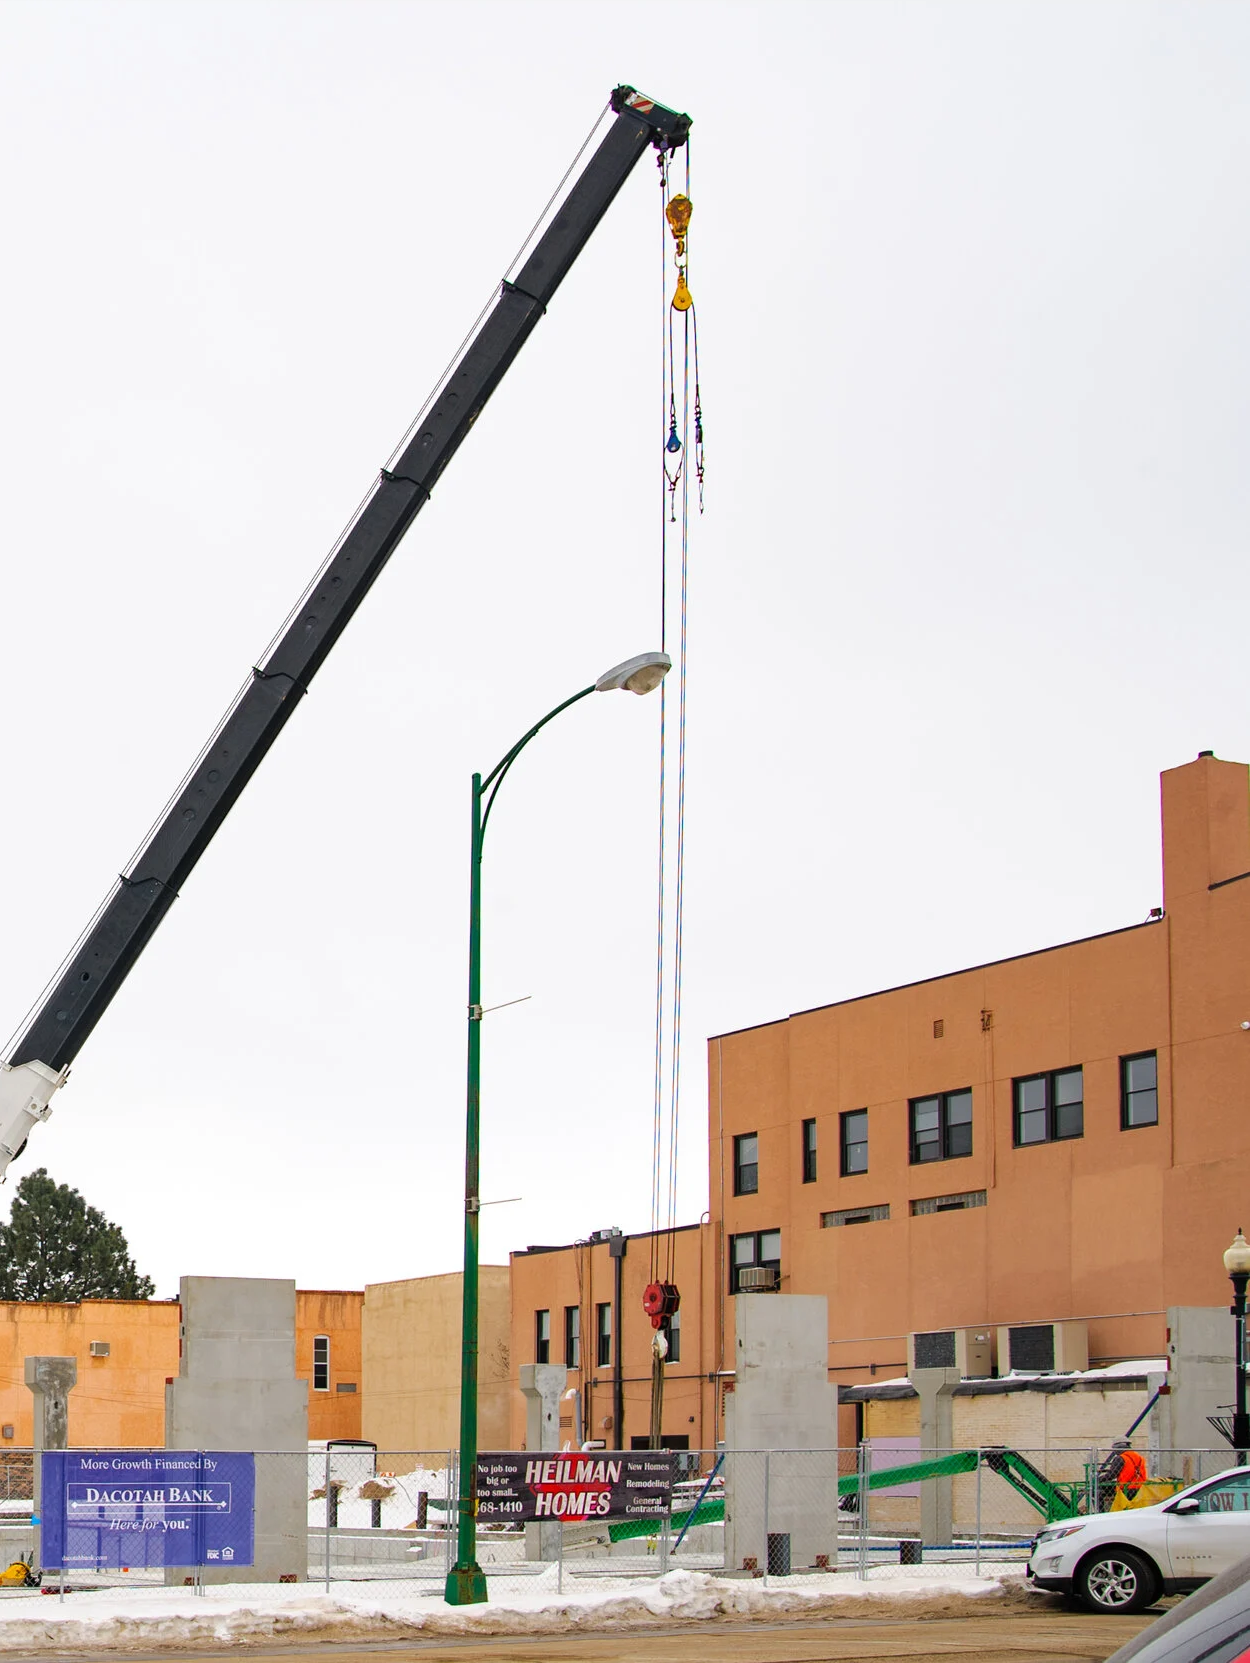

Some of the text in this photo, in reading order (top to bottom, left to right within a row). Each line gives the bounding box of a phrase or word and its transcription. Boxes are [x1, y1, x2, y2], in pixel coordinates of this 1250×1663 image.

[80, 1458, 218, 1471] More Growth Financed By
[478, 1464, 518, 1475] No job too
[627, 1462, 670, 1471] New Homes
[524, 1460, 623, 1485] HEILMAN
[486, 1476, 499, 1486] big
[626, 1479, 670, 1489] Remodeling
[86, 1487, 214, 1503] DACOTAH BANK
[477, 1489, 490, 1497] too
[534, 1492, 612, 1516] HOMES
[633, 1496, 662, 1505] General
[625, 1504, 669, 1514] Contracting
[109, 1517, 190, 1532] Here for you.
